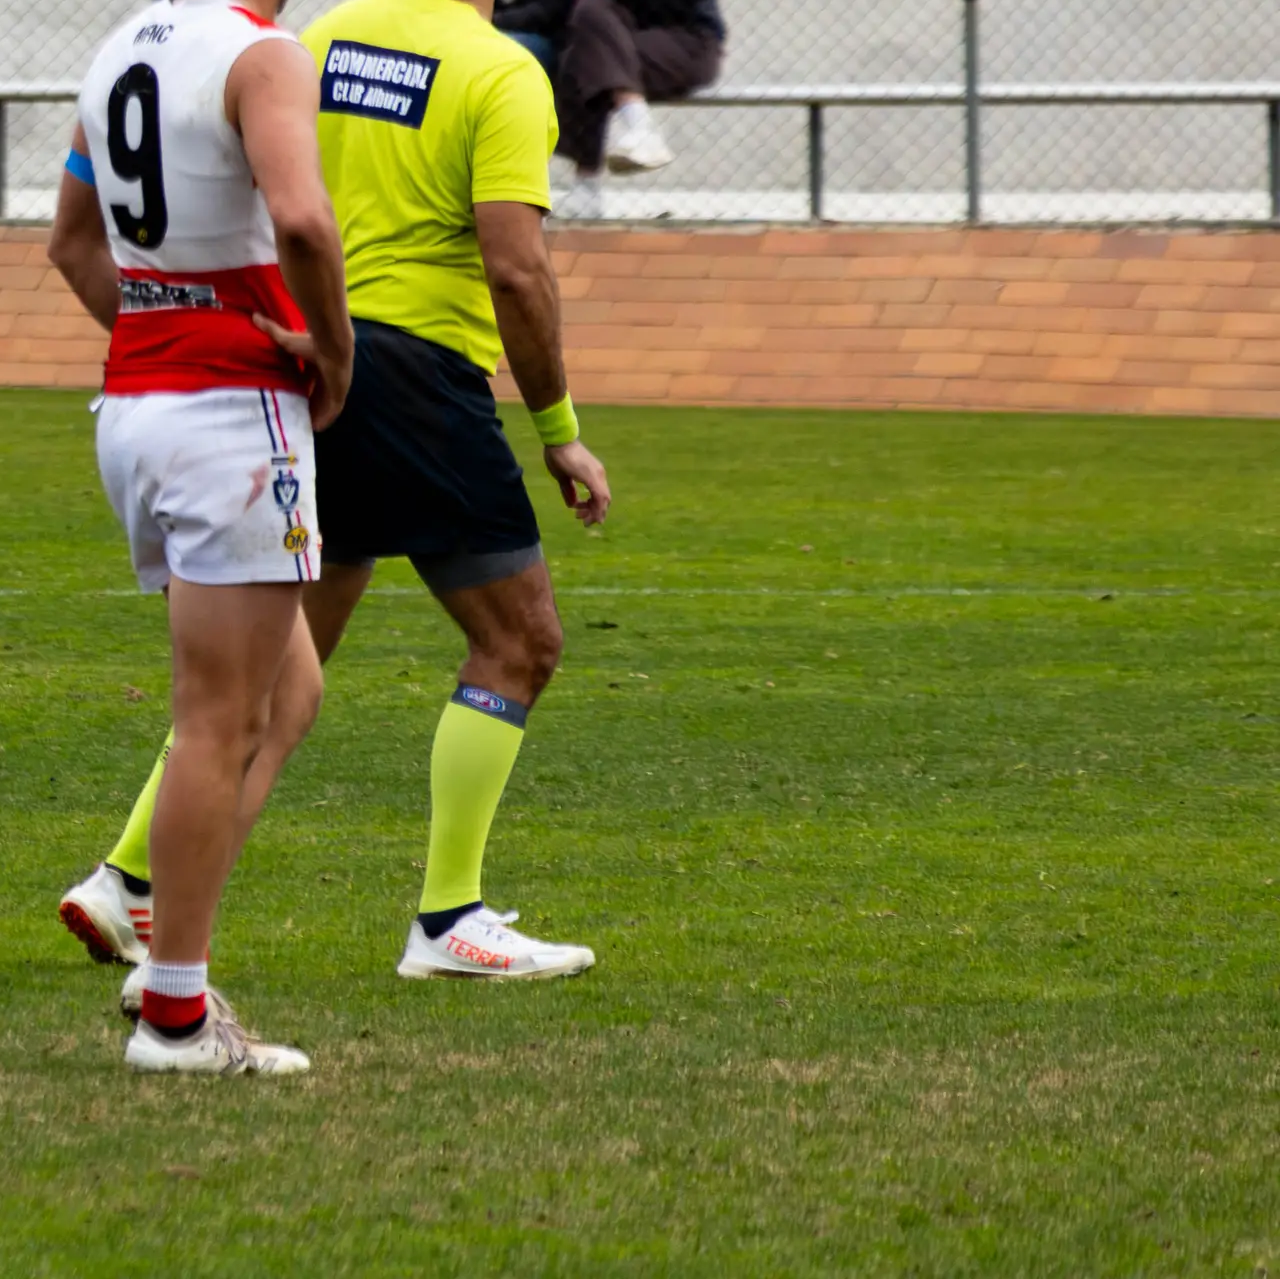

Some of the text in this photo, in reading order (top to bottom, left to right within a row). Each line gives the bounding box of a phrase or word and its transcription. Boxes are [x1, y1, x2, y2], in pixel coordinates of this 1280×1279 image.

[326, 48, 432, 91] COMMERCIAL
[363, 86, 414, 117] Albury
[107, 62, 168, 250] 9
[446, 935, 517, 971] TERREX
